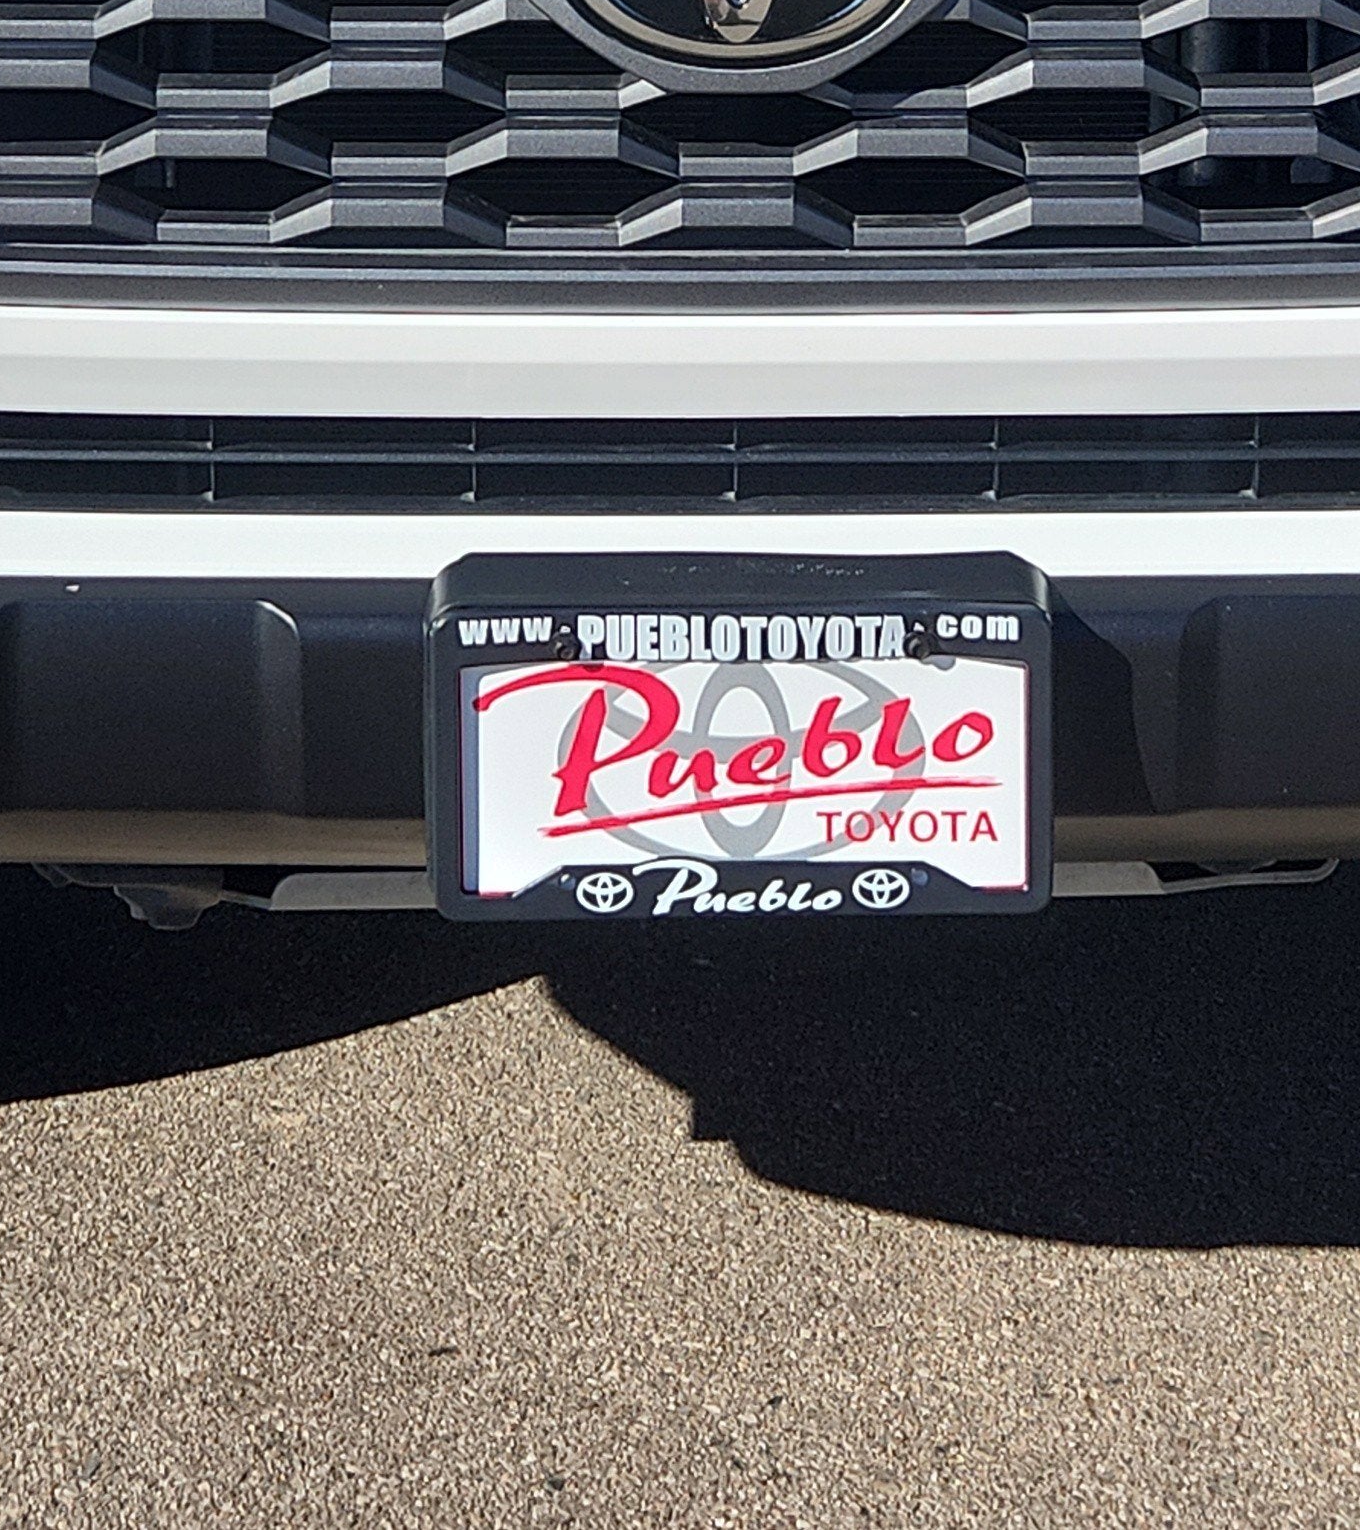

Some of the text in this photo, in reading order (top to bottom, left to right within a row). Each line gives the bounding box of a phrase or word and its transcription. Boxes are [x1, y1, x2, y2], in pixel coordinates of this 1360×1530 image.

[472, 662, 995, 817] Pueblo
[817, 810, 999, 844] TOYOTA
[632, 858, 843, 916] Pueblo
